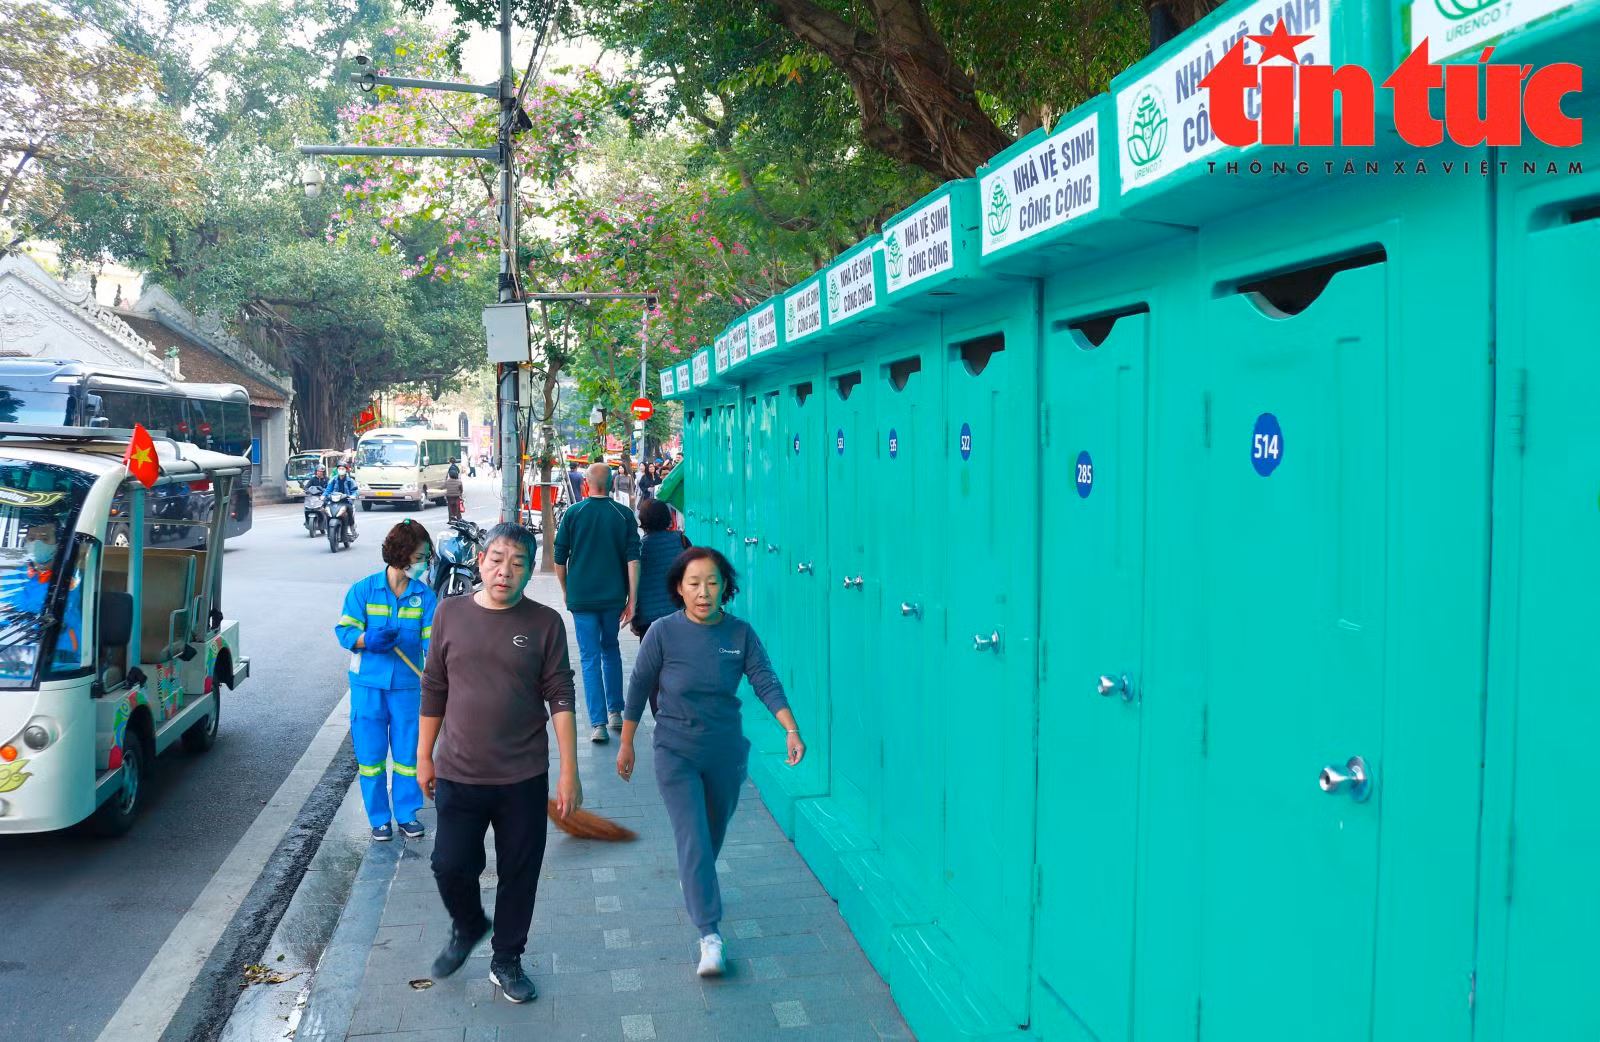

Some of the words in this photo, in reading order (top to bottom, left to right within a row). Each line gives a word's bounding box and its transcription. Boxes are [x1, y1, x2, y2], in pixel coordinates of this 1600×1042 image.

[1446, 8, 1501, 42] URENCO
[1505, 3, 1512, 17] 7
[1013, 154, 1039, 195] NHÀ
[1040, 143, 1058, 183] VỆ
[1062, 127, 1095, 171] SINH
[1019, 194, 1051, 232] CÔNG
[1055, 174, 1092, 218] CỘNG
[905, 219, 919, 248] NHÀ
[919, 211, 930, 242] VỆ
[930, 205, 949, 234] SINH
[928, 240, 949, 272] CỘNG
[961, 435, 971, 451] 522
[1254, 433, 1279, 459] 514
[1077, 464, 1092, 484] 285
